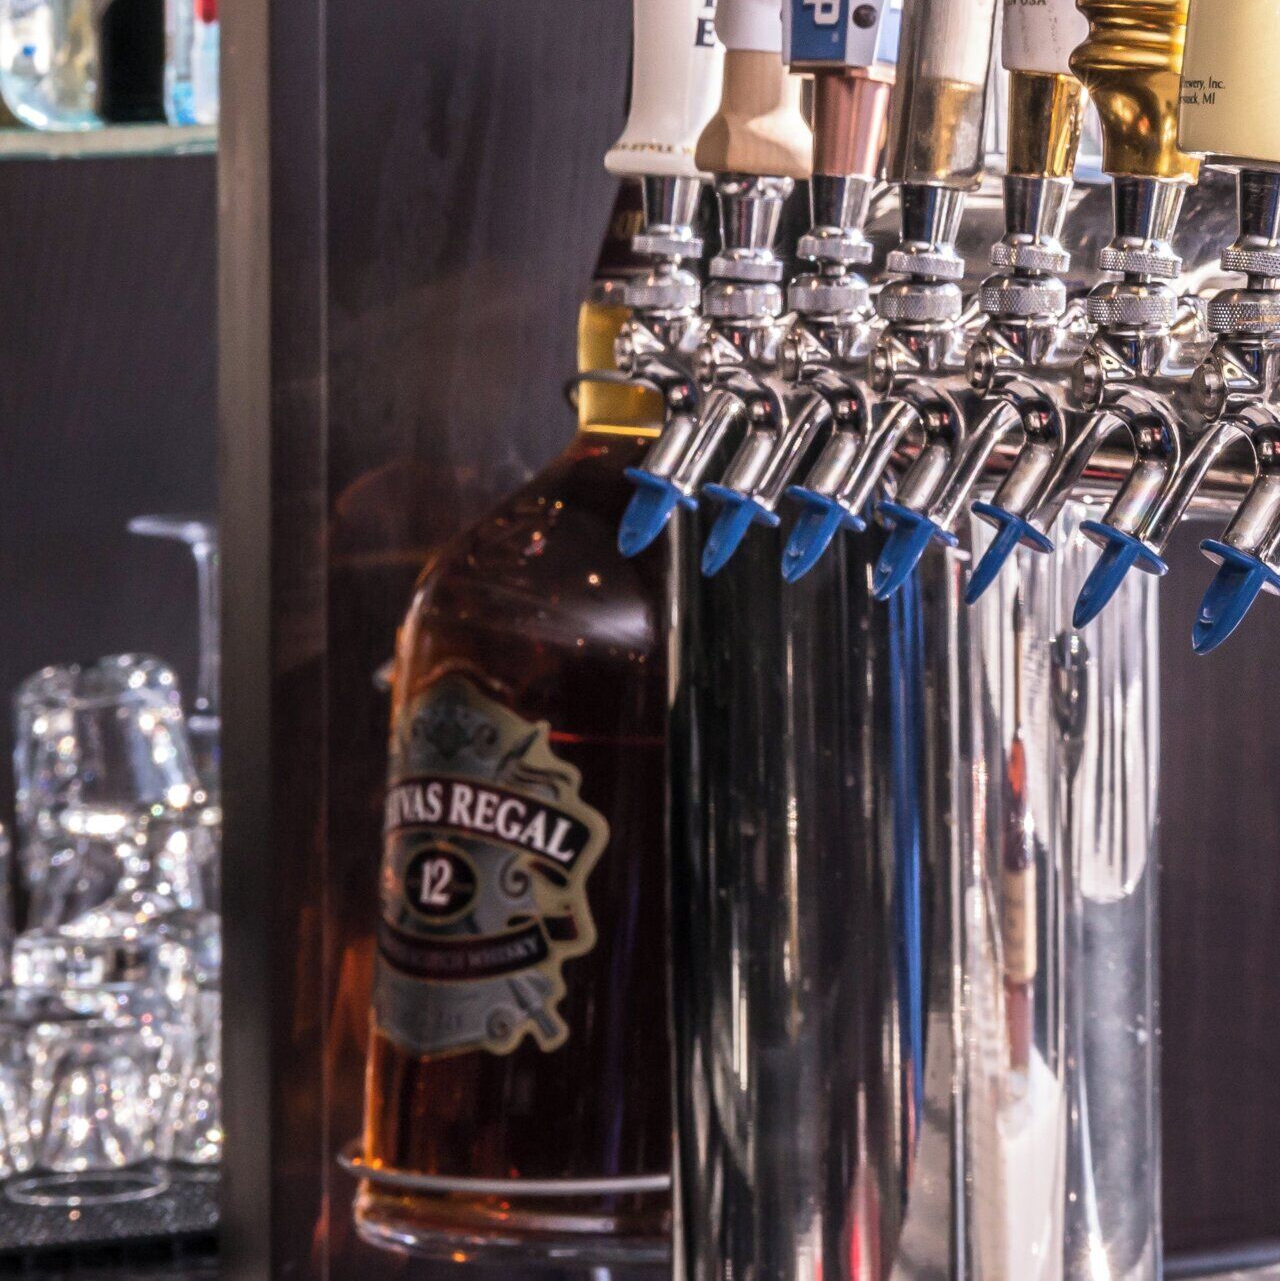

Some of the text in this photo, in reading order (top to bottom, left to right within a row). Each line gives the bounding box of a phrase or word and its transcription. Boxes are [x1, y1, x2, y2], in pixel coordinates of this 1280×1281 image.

[1202, 92, 1216, 105] MI
[1208, 76, 1226, 90] Inc.
[394, 780, 576, 863] VAS REGAL
[418, 857, 454, 906] 12
